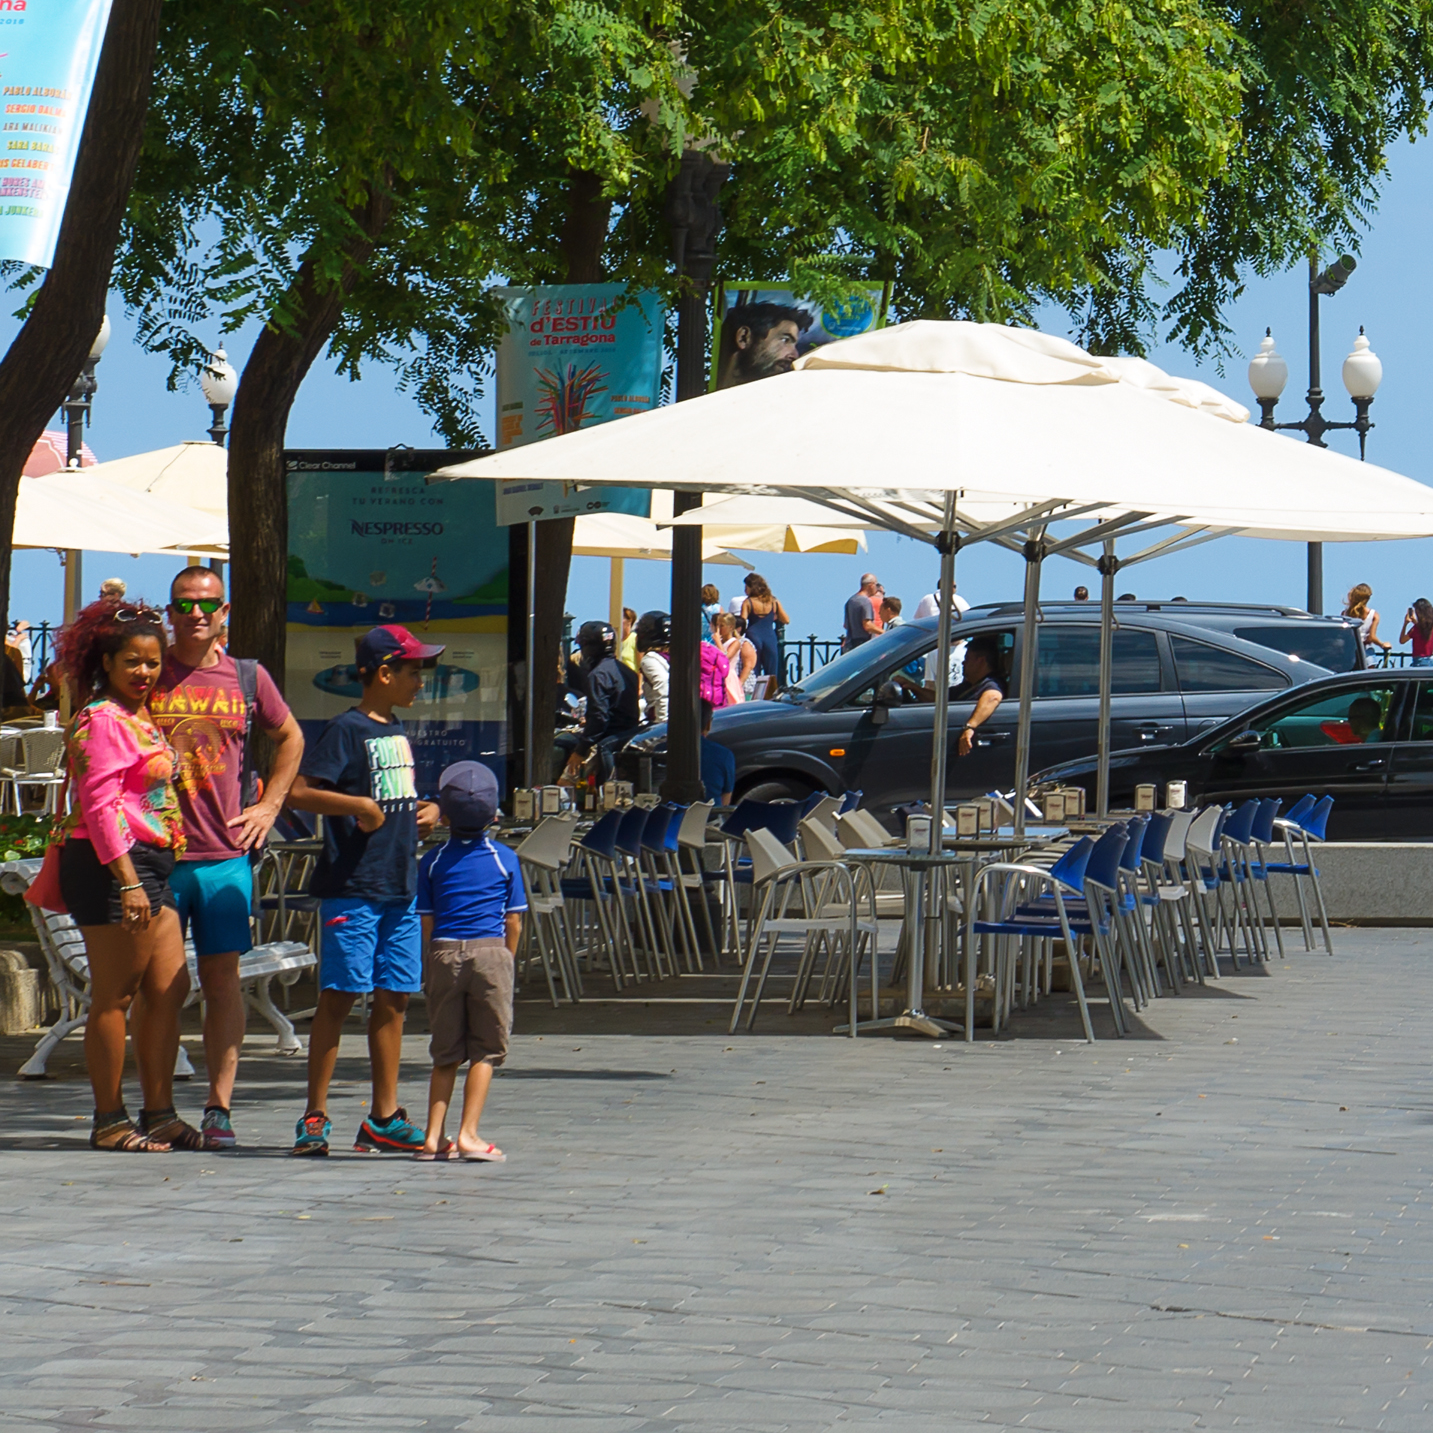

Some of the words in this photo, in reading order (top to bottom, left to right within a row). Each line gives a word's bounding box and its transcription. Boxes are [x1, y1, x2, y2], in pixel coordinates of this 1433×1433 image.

[3, 86, 31, 96] PABLO
[5, 104, 36, 114] SERGIO
[3, 122, 19, 131] ARA
[6, 140, 29, 150] SARA
[530, 315, 618, 334] d'ESTIU
[530, 338, 542, 346] de
[543, 333, 616, 347] Tarragona
[300, 461, 320, 470] Clear
[321, 461, 356, 470] Channel
[370, 486, 425, 494] REFRESCA
[370, 498, 416, 506] VERANO
[350, 519, 444, 538] NESPRESSO
